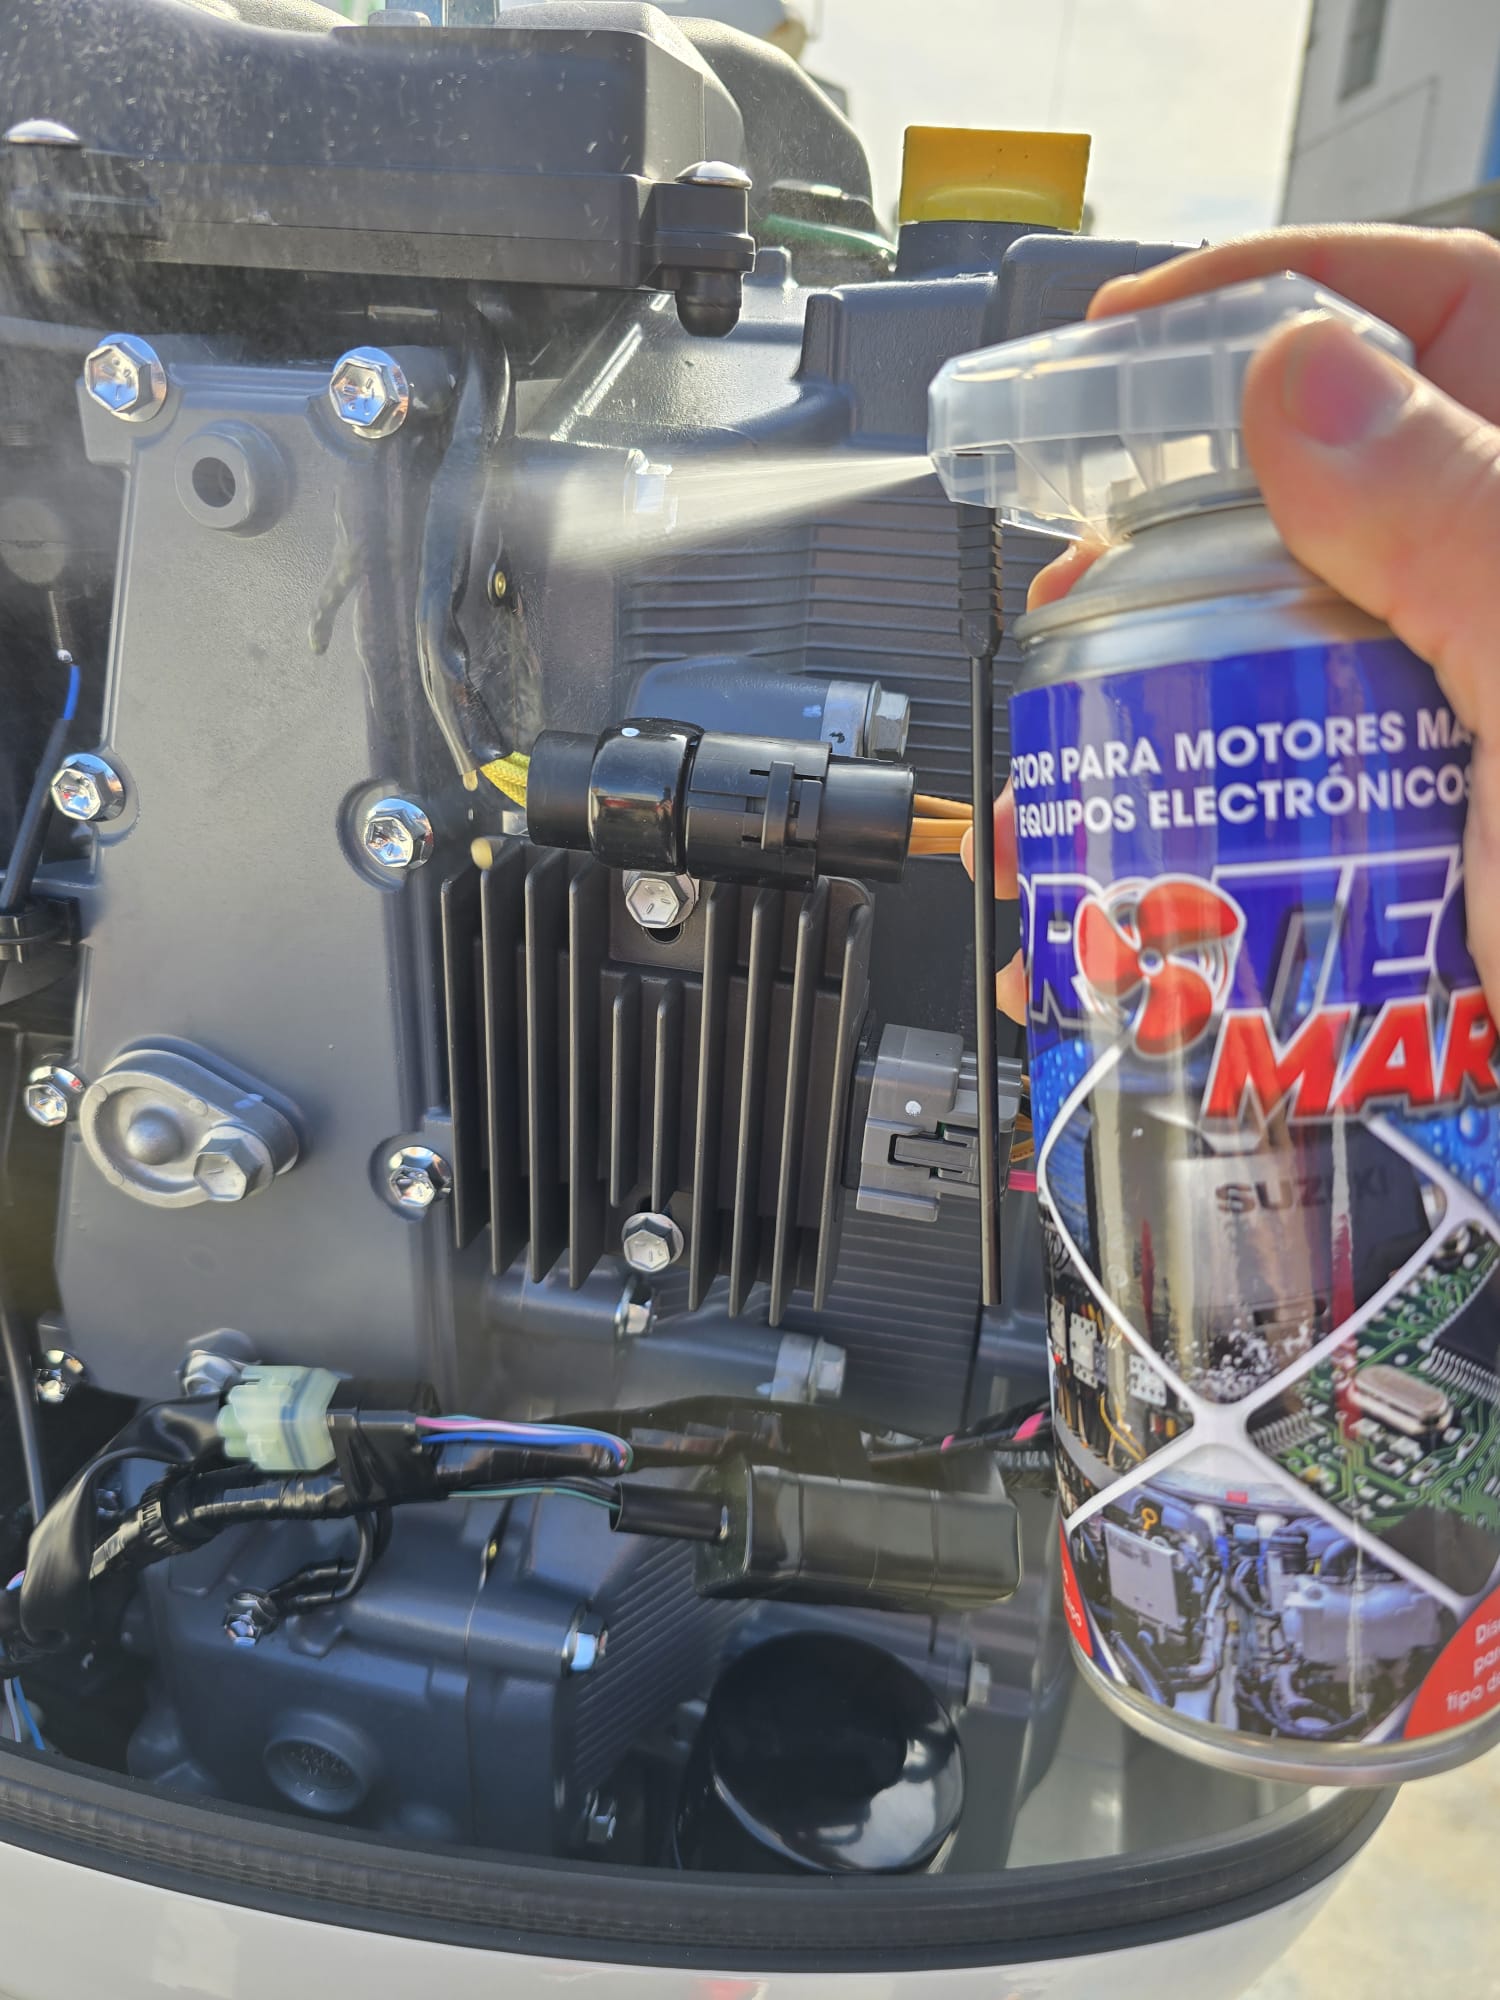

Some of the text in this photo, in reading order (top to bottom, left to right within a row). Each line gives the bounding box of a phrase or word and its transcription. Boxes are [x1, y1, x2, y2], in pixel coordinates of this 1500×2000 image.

[1061, 736, 1161, 784] PARA
[1174, 711, 1406, 772] MOTORES
[1018, 794, 1136, 838] EQUIPOS
[1200, 985, 1500, 1124] MAR
[1475, 1618, 1500, 1645] Dis
